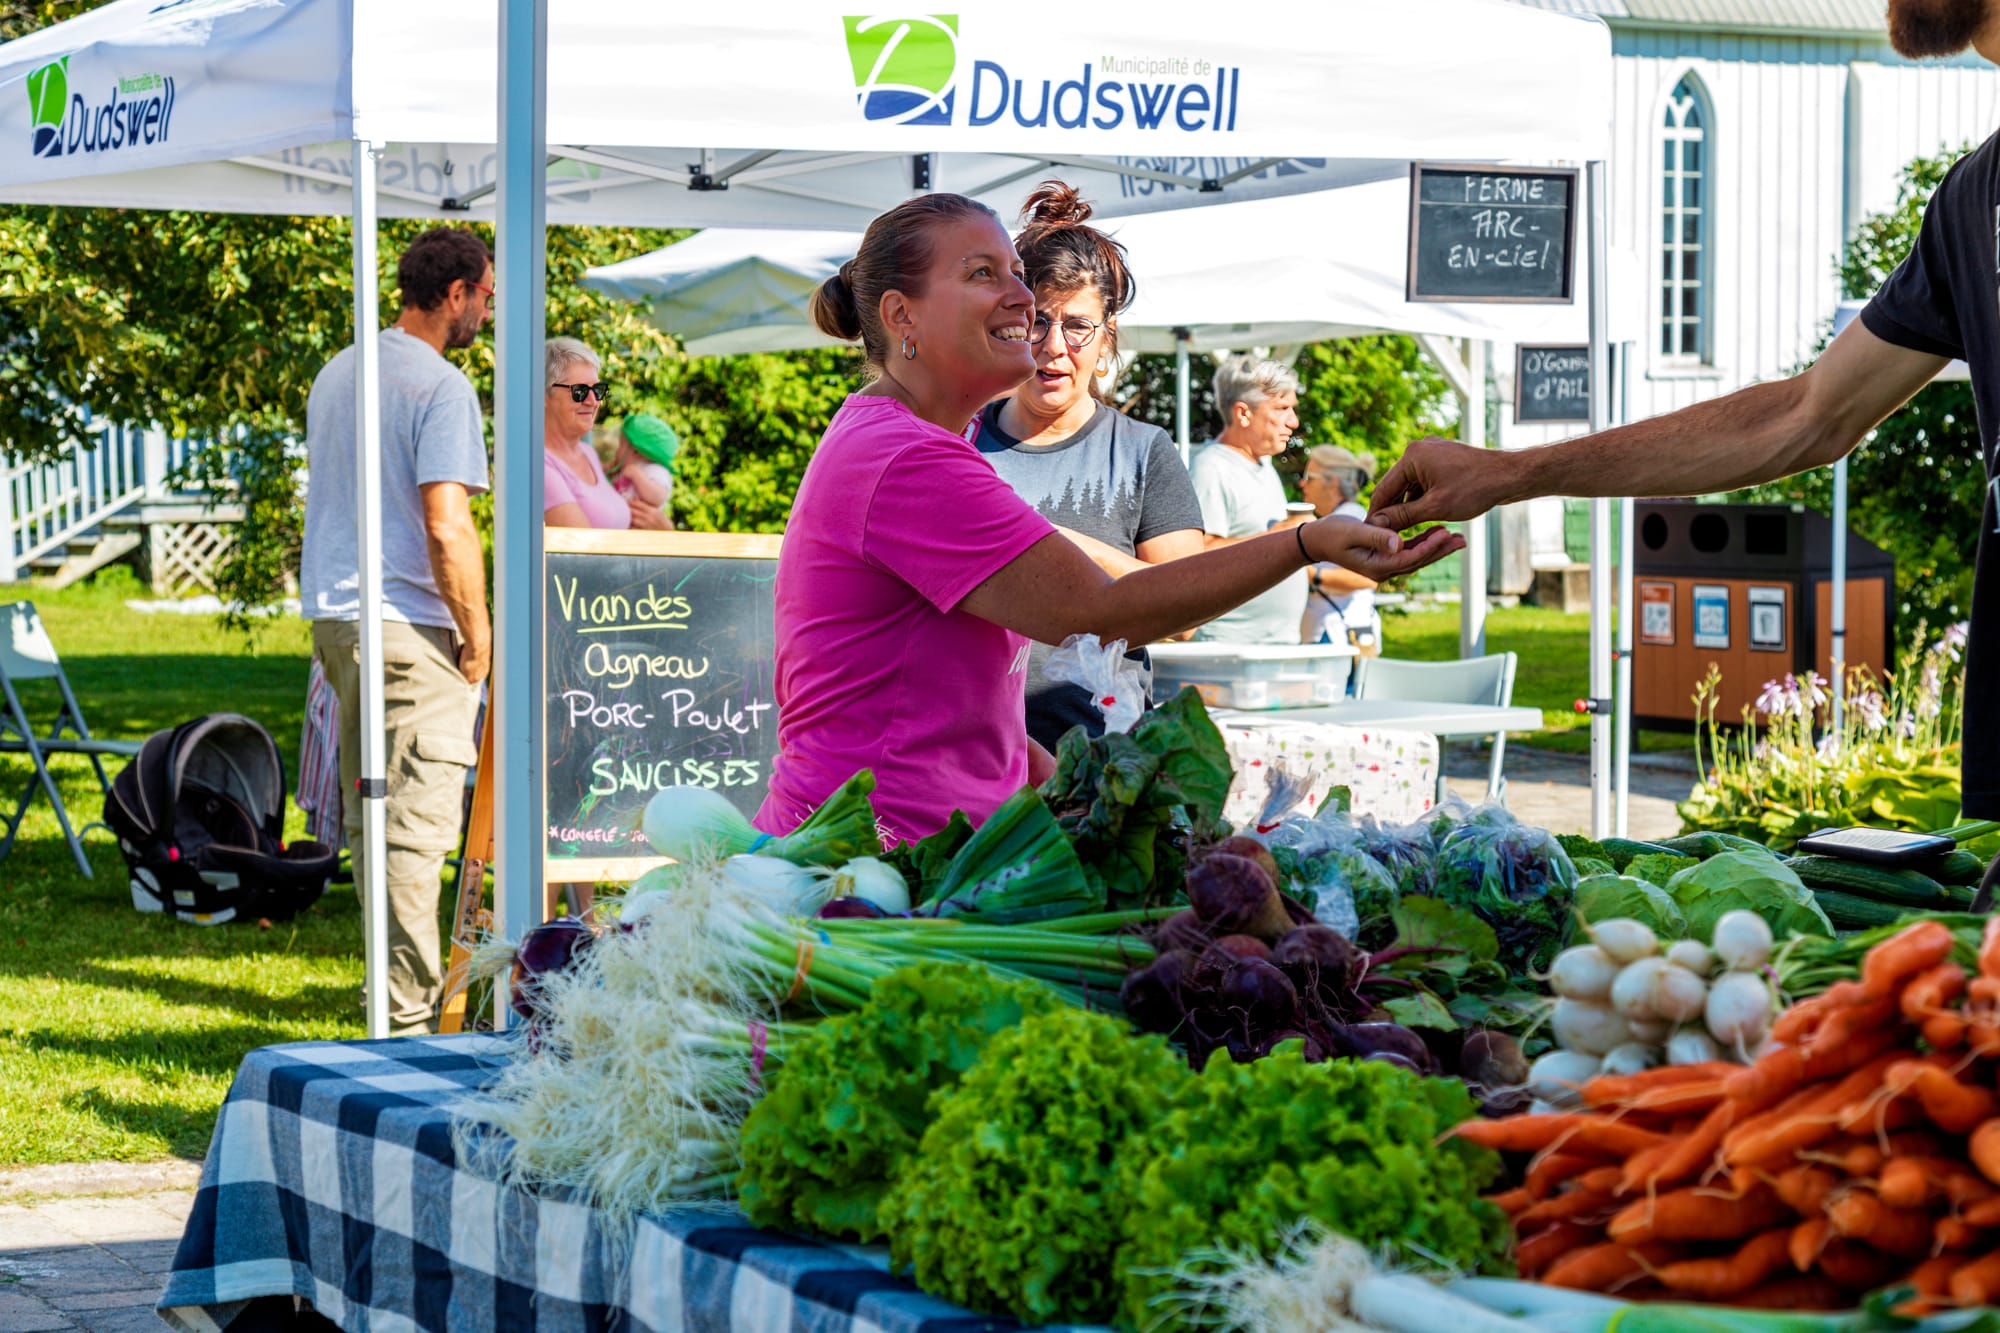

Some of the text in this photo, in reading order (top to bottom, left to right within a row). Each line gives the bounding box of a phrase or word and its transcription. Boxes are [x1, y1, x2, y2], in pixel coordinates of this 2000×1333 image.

[1101, 55, 1211, 77] Municipalité de
[67, 75, 174, 155] Dudswell
[968, 60, 1240, 132] Dudswell
[1465, 175, 1545, 202] FERME
[553, 573, 693, 624] Viandes
[661, 688, 773, 735] Poulet
